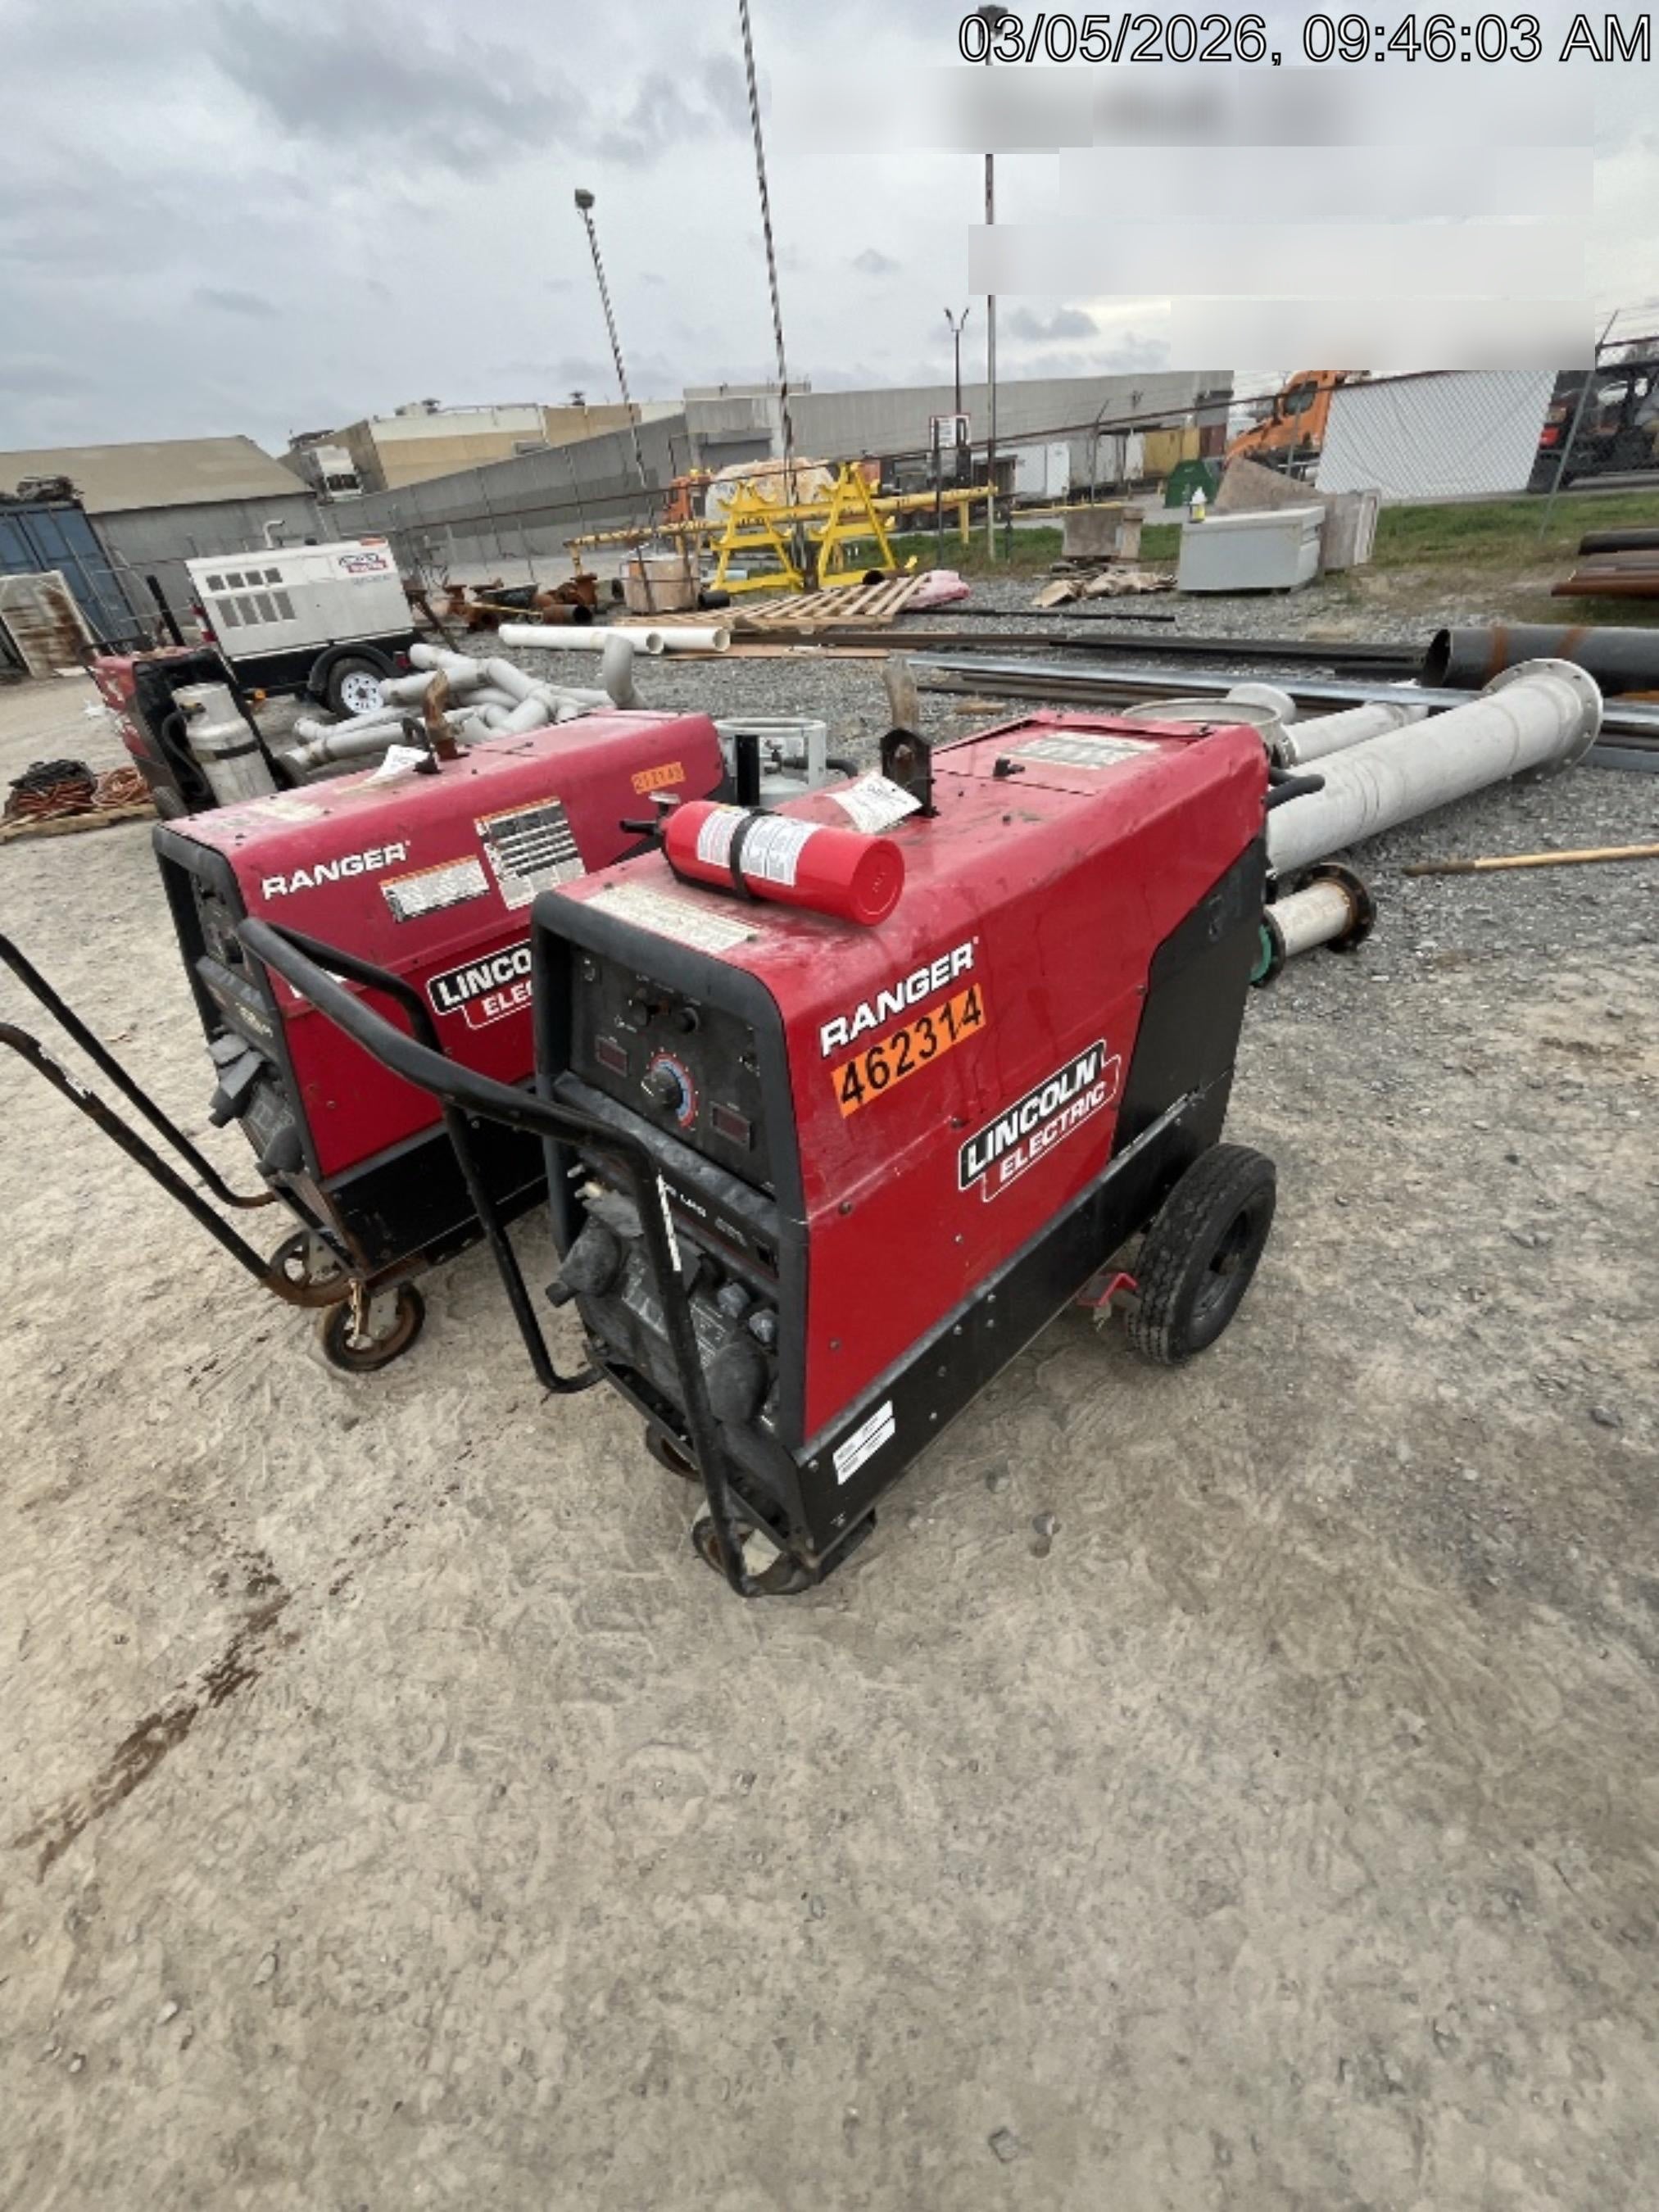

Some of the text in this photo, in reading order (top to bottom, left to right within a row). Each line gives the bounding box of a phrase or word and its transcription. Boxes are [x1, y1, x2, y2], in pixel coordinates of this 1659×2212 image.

[262, 842, 406, 900] RANGER
[820, 941, 973, 1058] RANGER
[841, 987, 981, 1104] 462314
[968, 1051, 1097, 1178] LINCOLN
[999, 1081, 1106, 1182] ELECTRIC
